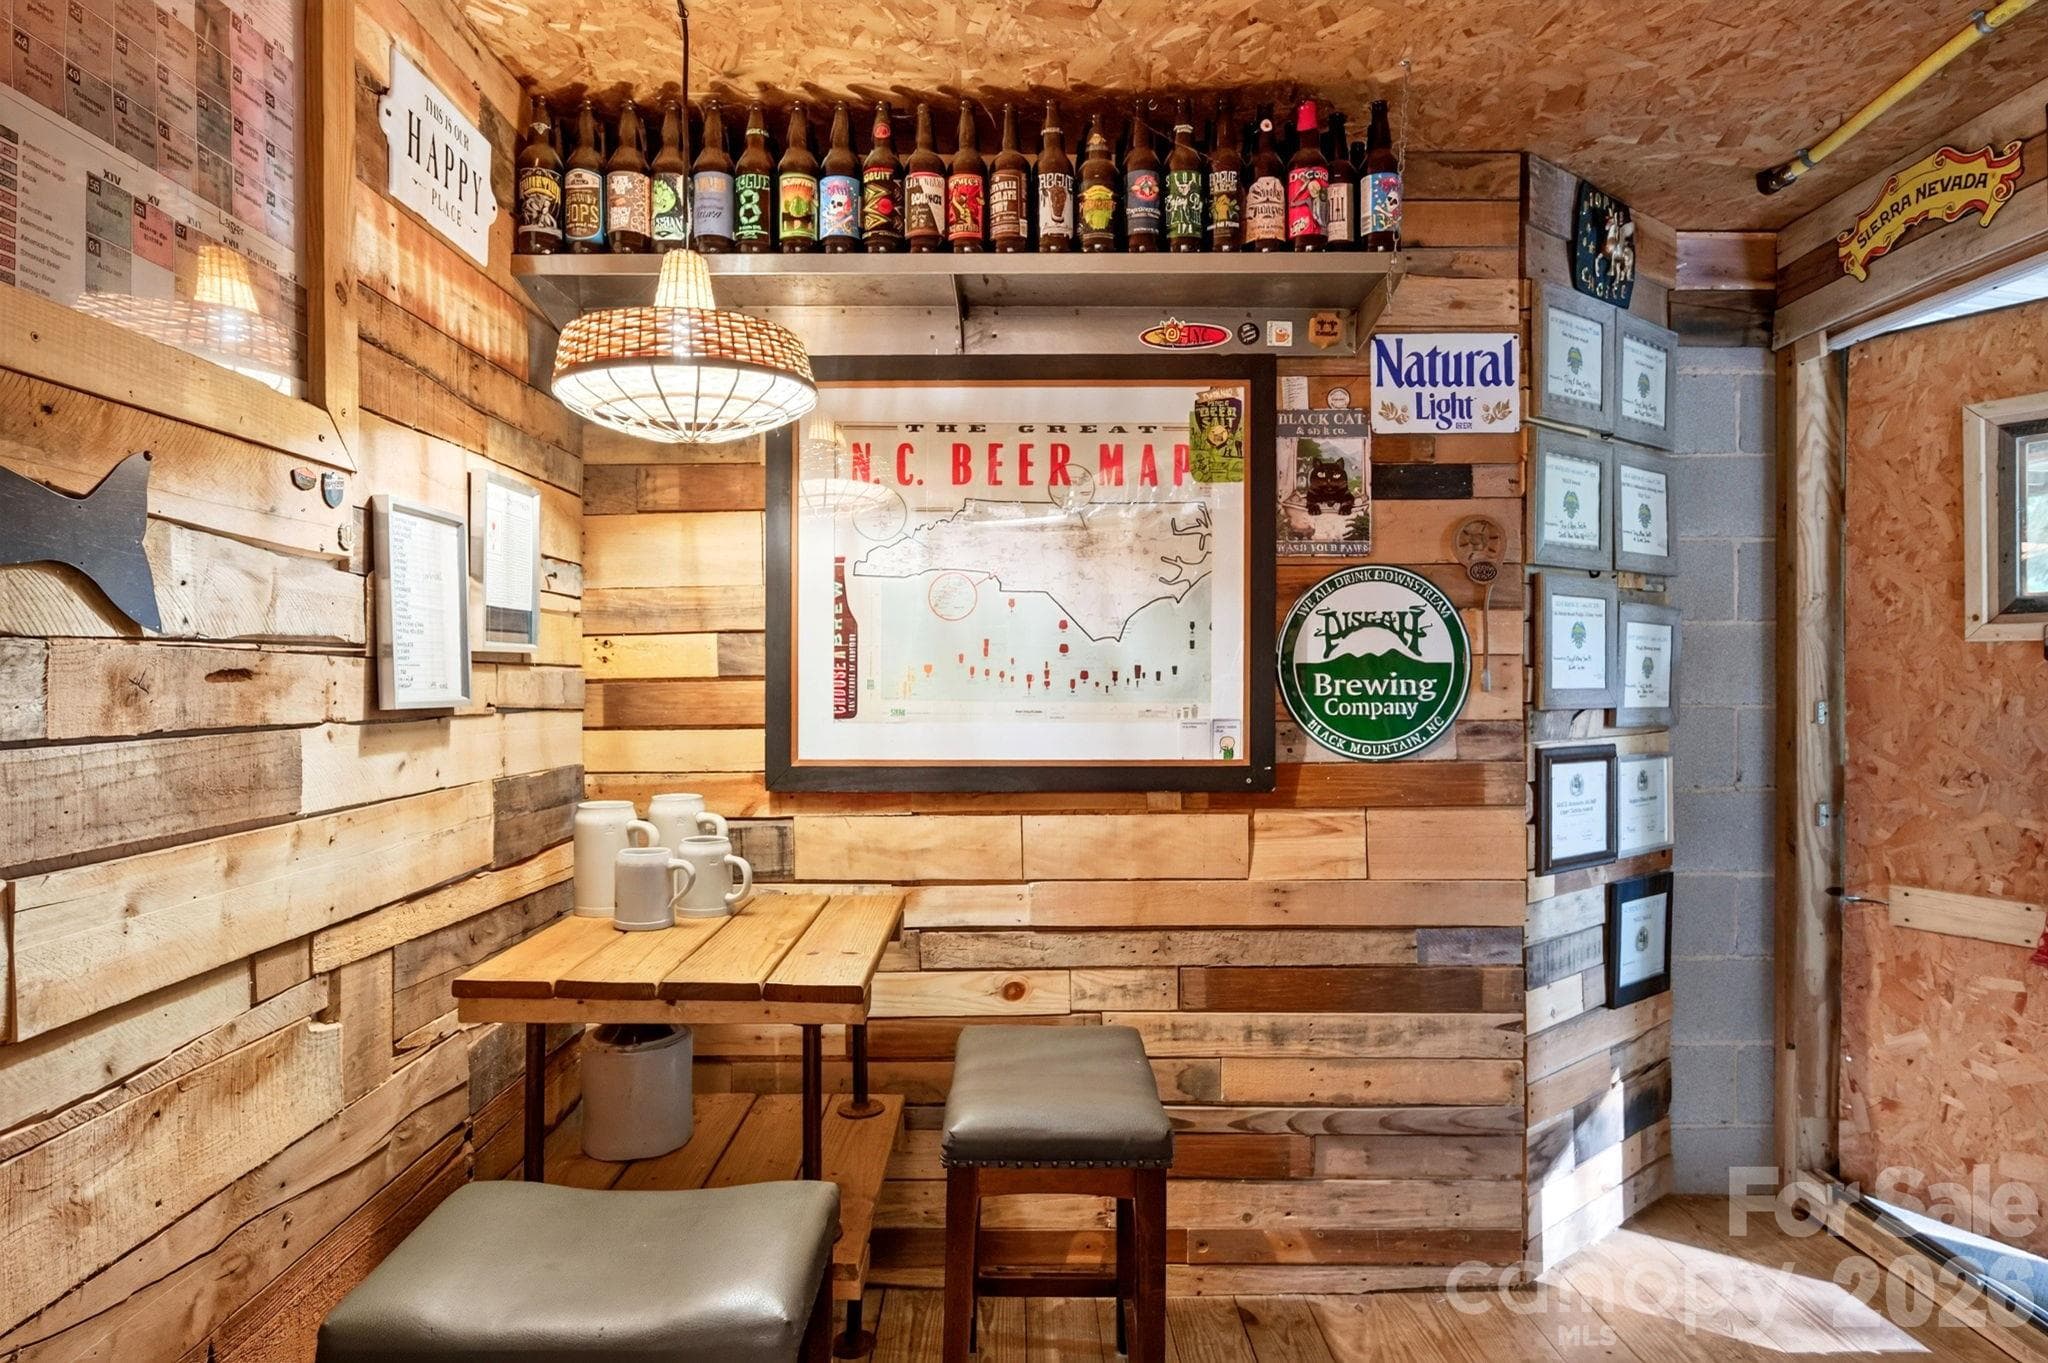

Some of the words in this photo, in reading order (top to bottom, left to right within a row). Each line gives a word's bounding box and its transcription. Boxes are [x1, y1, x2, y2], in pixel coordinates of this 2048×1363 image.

[424, 94, 443, 125] THIS
[444, 115, 453, 133] IS
[454, 124, 470, 151] OUR
[407, 109, 482, 216] HAPPY
[431, 188, 462, 227] PLACE
[1857, 193, 1912, 249] SIERRA
[1915, 172, 1989, 205] NEVADA
[1375, 338, 1515, 388] Natural
[905, 424, 987, 433] THE
[1018, 425, 1159, 434] GREAT
[1278, 413, 1330, 425] BLACK
[1333, 413, 1365, 425] CAT
[1415, 391, 1473, 430] Light
[951, 442, 1072, 487] BEER
[1098, 443, 1190, 487] MAP
[1310, 543, 1338, 552] YOUR
[1297, 598, 1317, 617] WE
[1315, 586, 1335, 604] ALL
[1335, 570, 1374, 588] DRINK
[1374, 569, 1452, 618] DOWNSTREAM
[1314, 603, 1433, 659] PISGAH
[834, 650, 846, 660] A
[833, 662, 847, 714] CHOOSE
[1314, 672, 1437, 701] Brewing
[1324, 698, 1419, 719] Company
[1307, 718, 1346, 750] BLACK
[1350, 734, 1426, 755] MOUNTAIN,
[1426, 715, 1445, 734] NC
